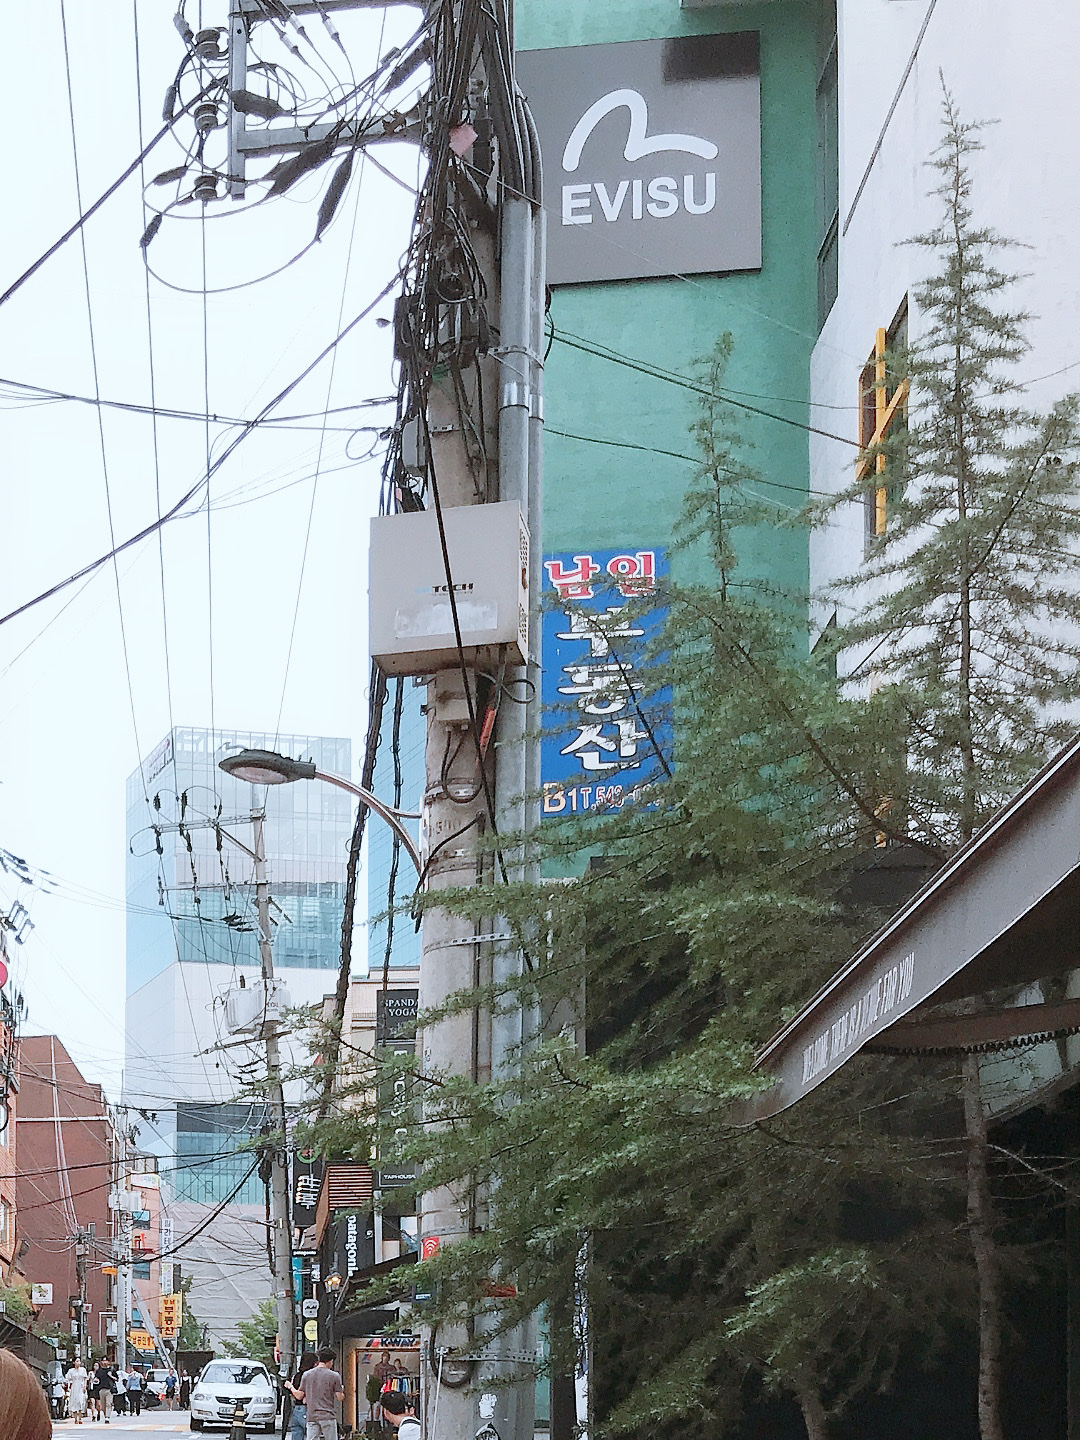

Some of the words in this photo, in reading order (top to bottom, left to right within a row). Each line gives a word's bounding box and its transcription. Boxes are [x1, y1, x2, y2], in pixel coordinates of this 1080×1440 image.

[561, 172, 717, 227] EVISU
[556, 606, 649, 771] 부동산
[389, 1008, 416, 1017] YOGA
